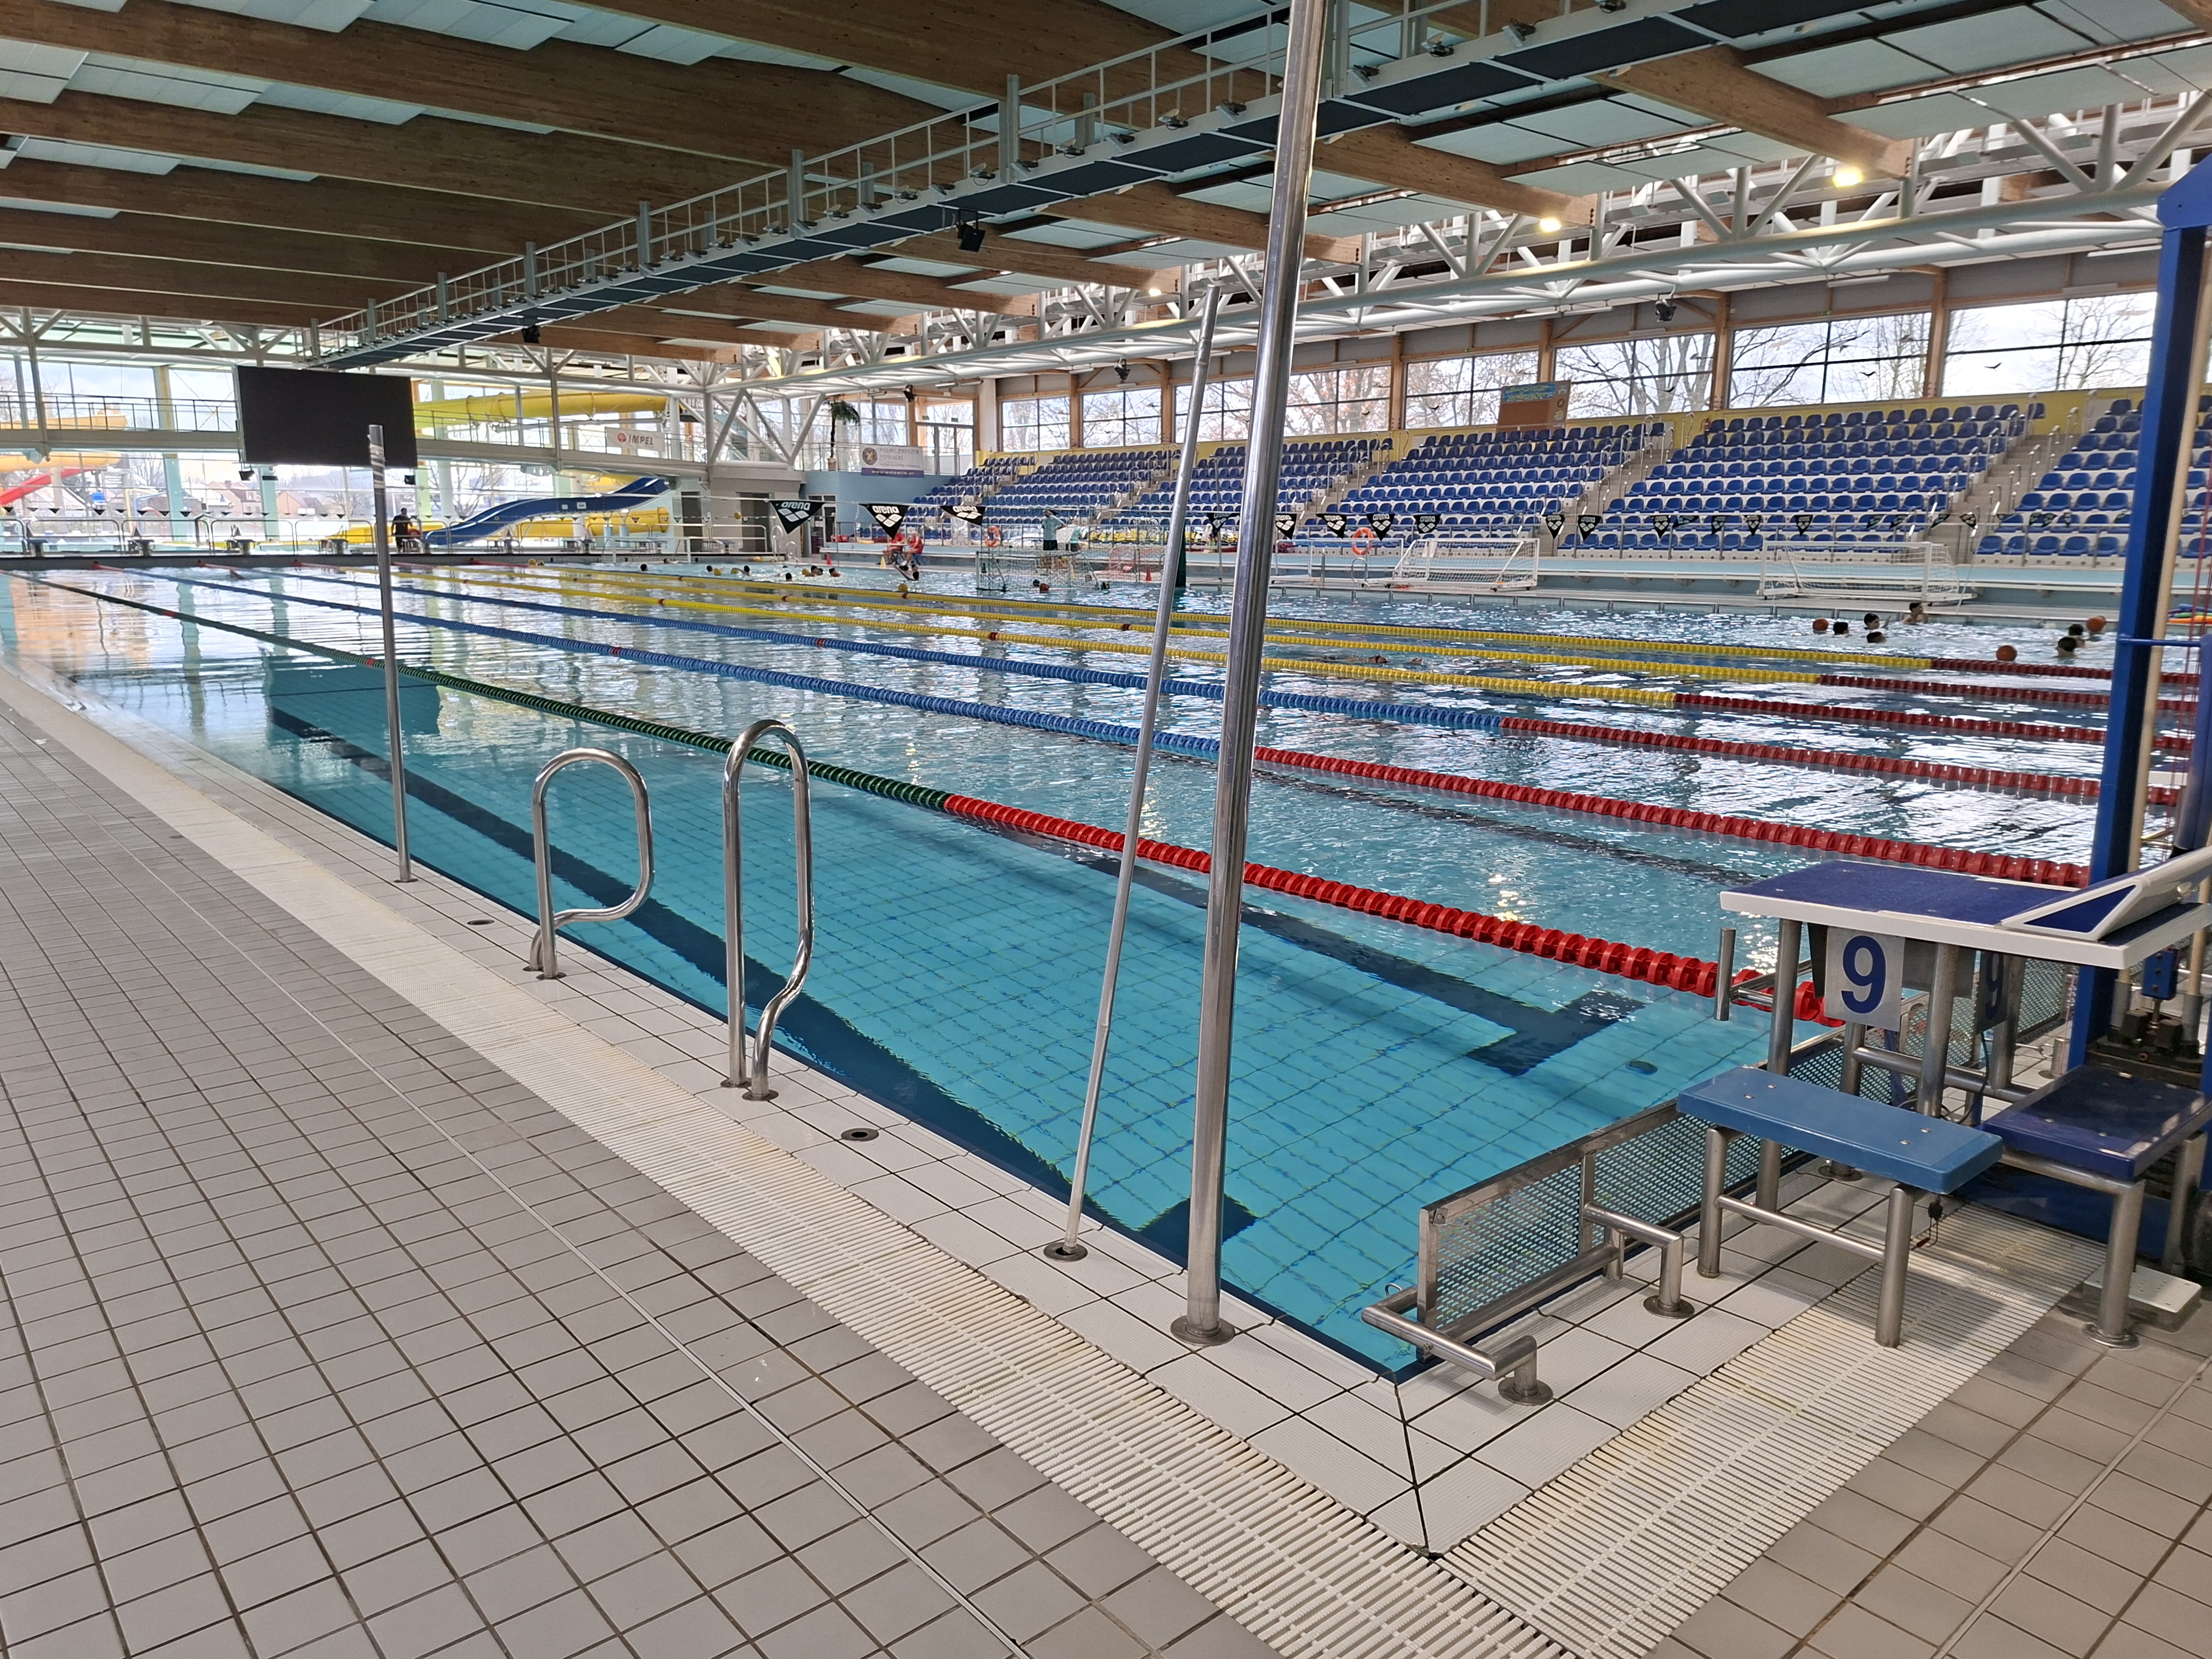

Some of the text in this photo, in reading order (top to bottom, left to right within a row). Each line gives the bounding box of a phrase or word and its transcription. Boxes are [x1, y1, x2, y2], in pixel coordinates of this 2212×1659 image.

[628, 434, 654, 446] IMPEL
[781, 502, 811, 511] arena
[872, 505, 900, 514] arena
[1841, 935, 1886, 1014] 9
[1986, 952, 2004, 1021] 9
